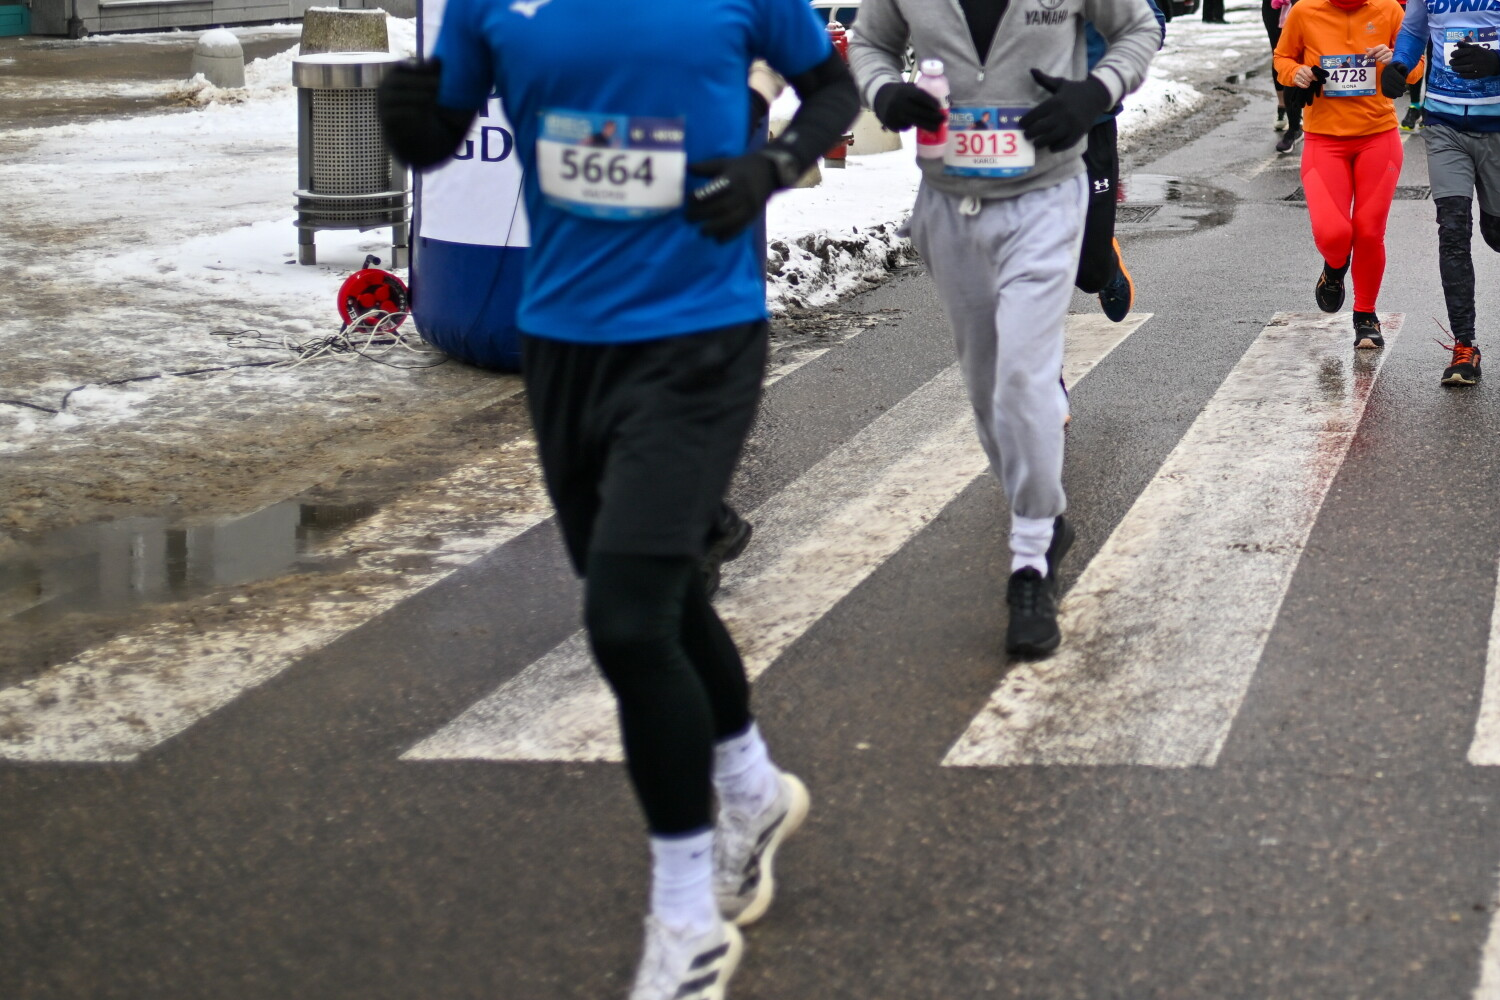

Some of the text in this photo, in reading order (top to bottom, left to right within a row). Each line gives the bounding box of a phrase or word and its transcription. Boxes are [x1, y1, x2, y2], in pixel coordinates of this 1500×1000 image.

[1330, 68, 1368, 83] 4728
[954, 132, 1018, 155] 3013
[559, 148, 656, 187] 5664
